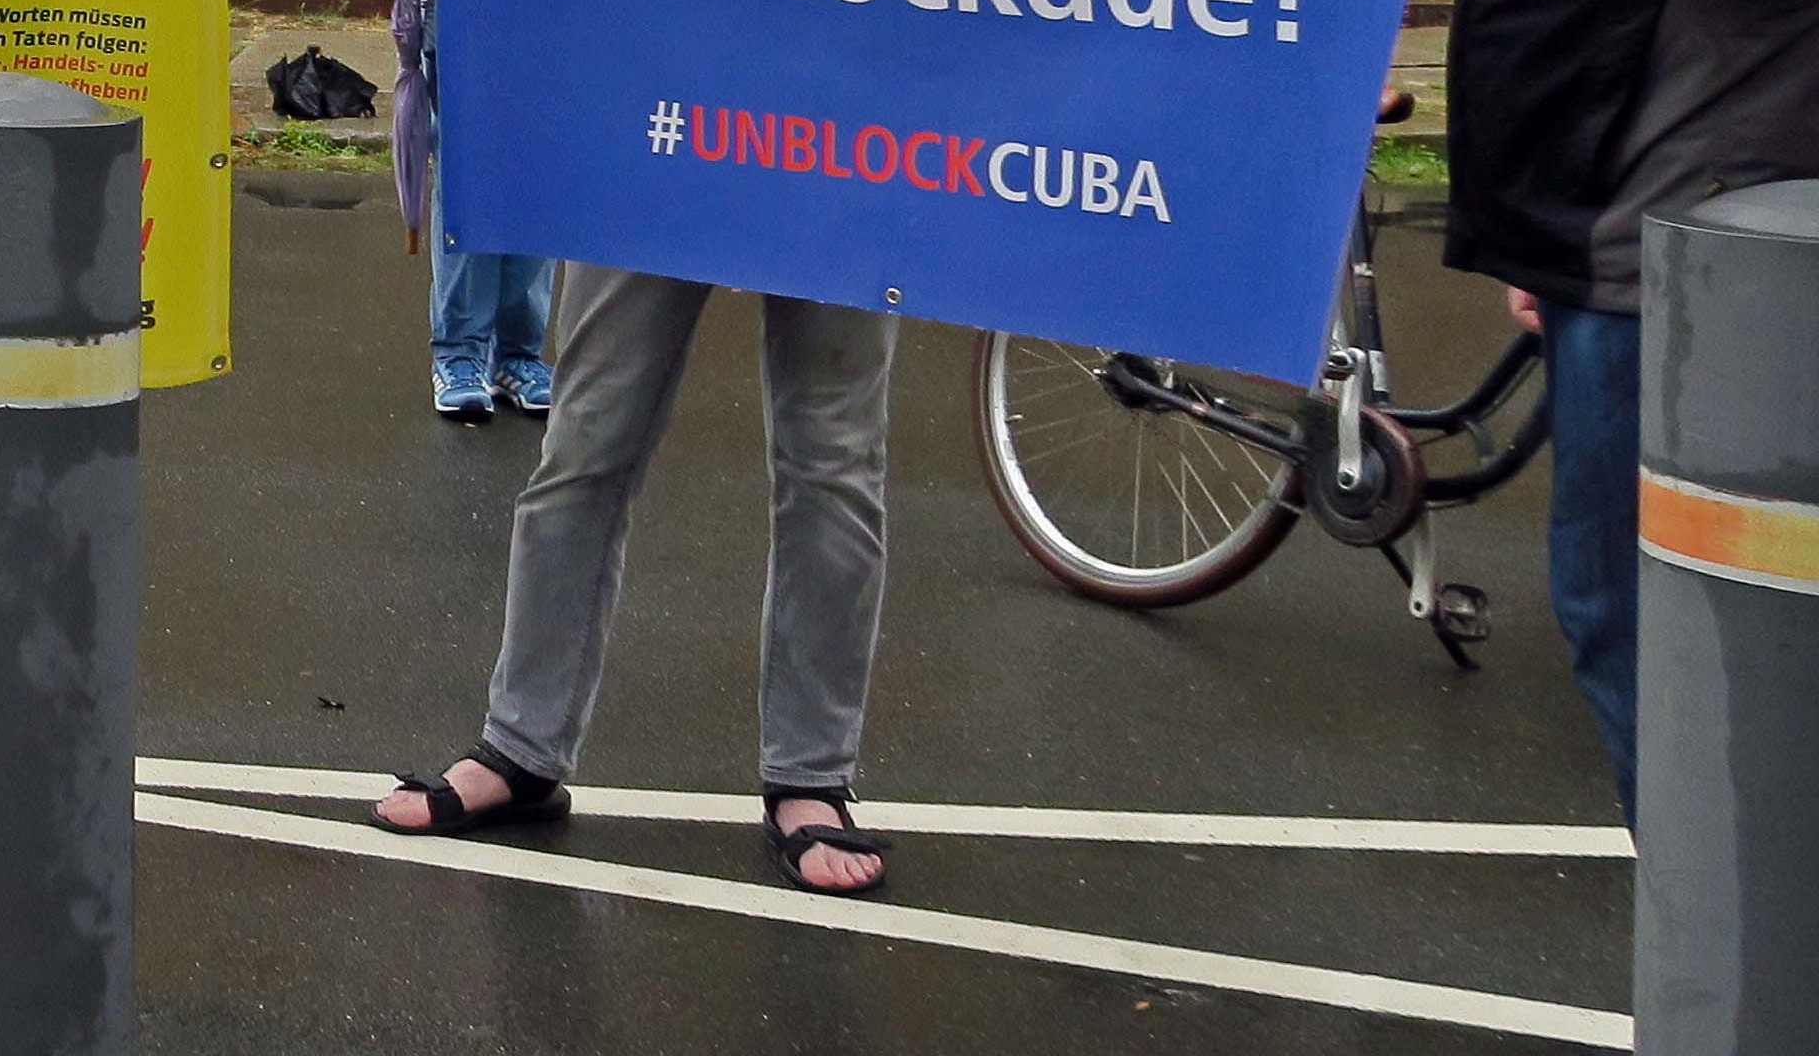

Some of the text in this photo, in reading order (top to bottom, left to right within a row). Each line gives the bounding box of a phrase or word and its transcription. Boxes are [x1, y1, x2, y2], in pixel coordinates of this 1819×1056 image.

[68, 9, 147, 30] müssen
[13, 30, 70, 47] Taten
[75, 30, 147, 54] folgen:
[13, 53, 104, 72] Handels-
[110, 61, 149, 78] und
[646, 99, 1172, 224] #UNBLOCKCUBA
